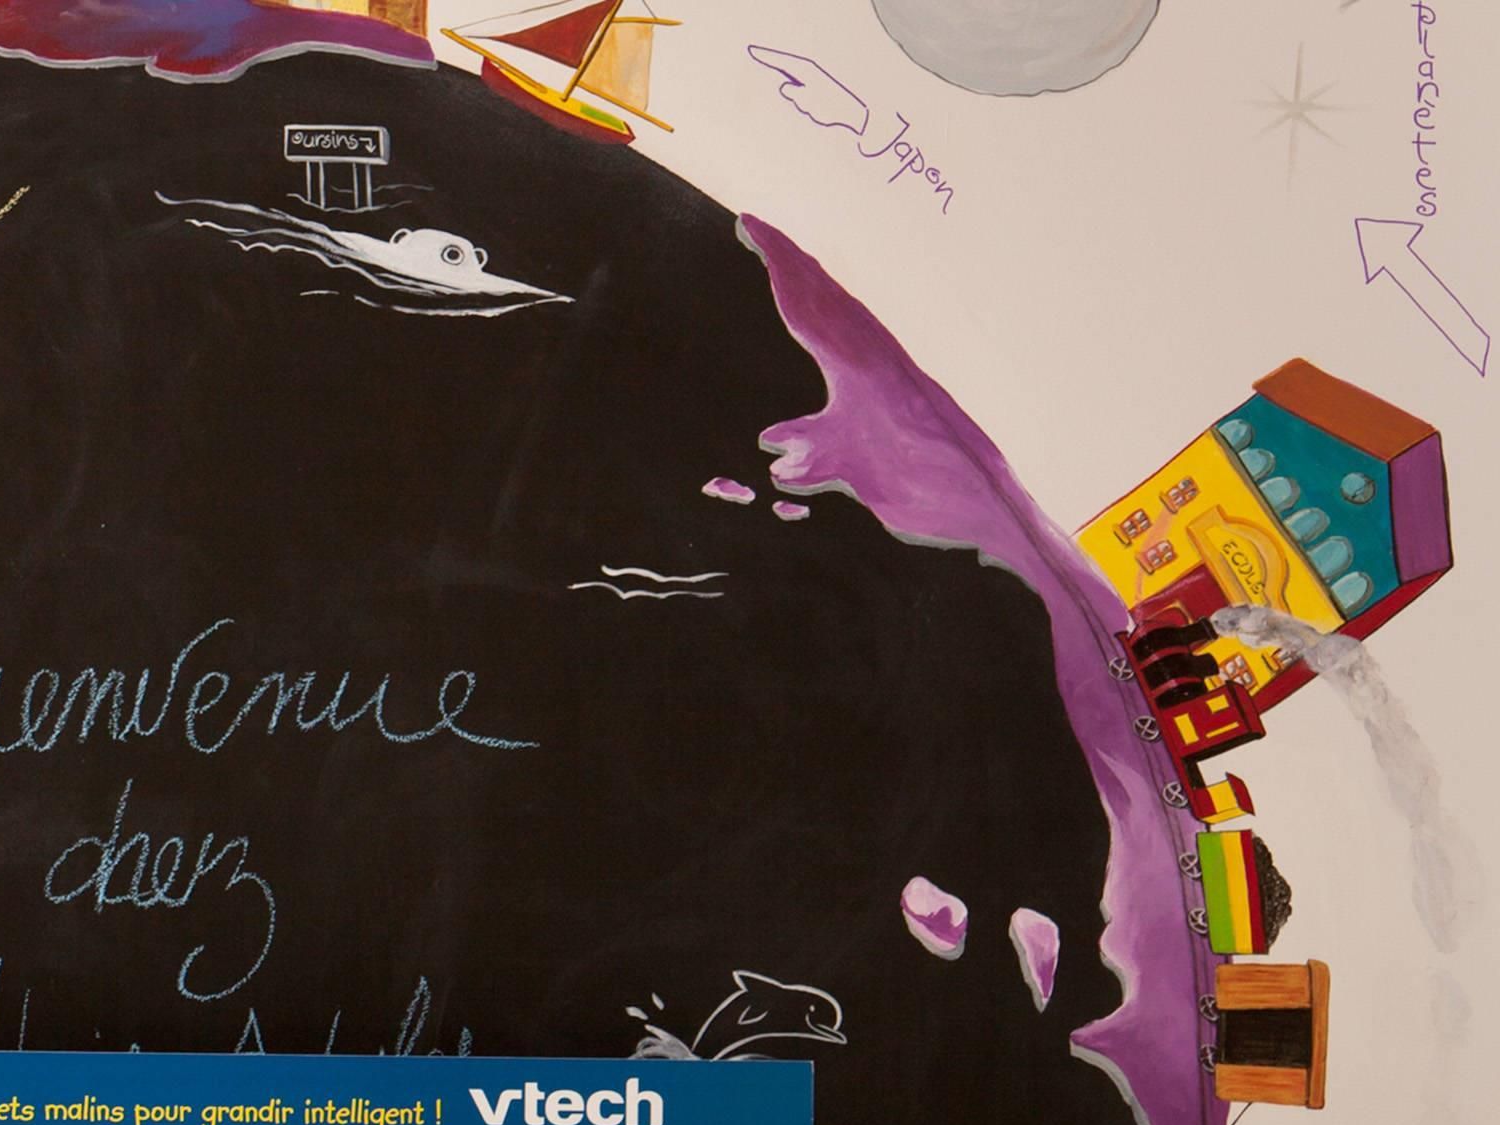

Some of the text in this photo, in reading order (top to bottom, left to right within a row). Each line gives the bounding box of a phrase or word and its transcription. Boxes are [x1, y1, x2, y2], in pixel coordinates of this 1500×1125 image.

[857, 111, 954, 215] Japon
[44, 777, 277, 1001] chez
[44, 1096, 125, 1123] malins
[435, 1099, 443, 1125] !
